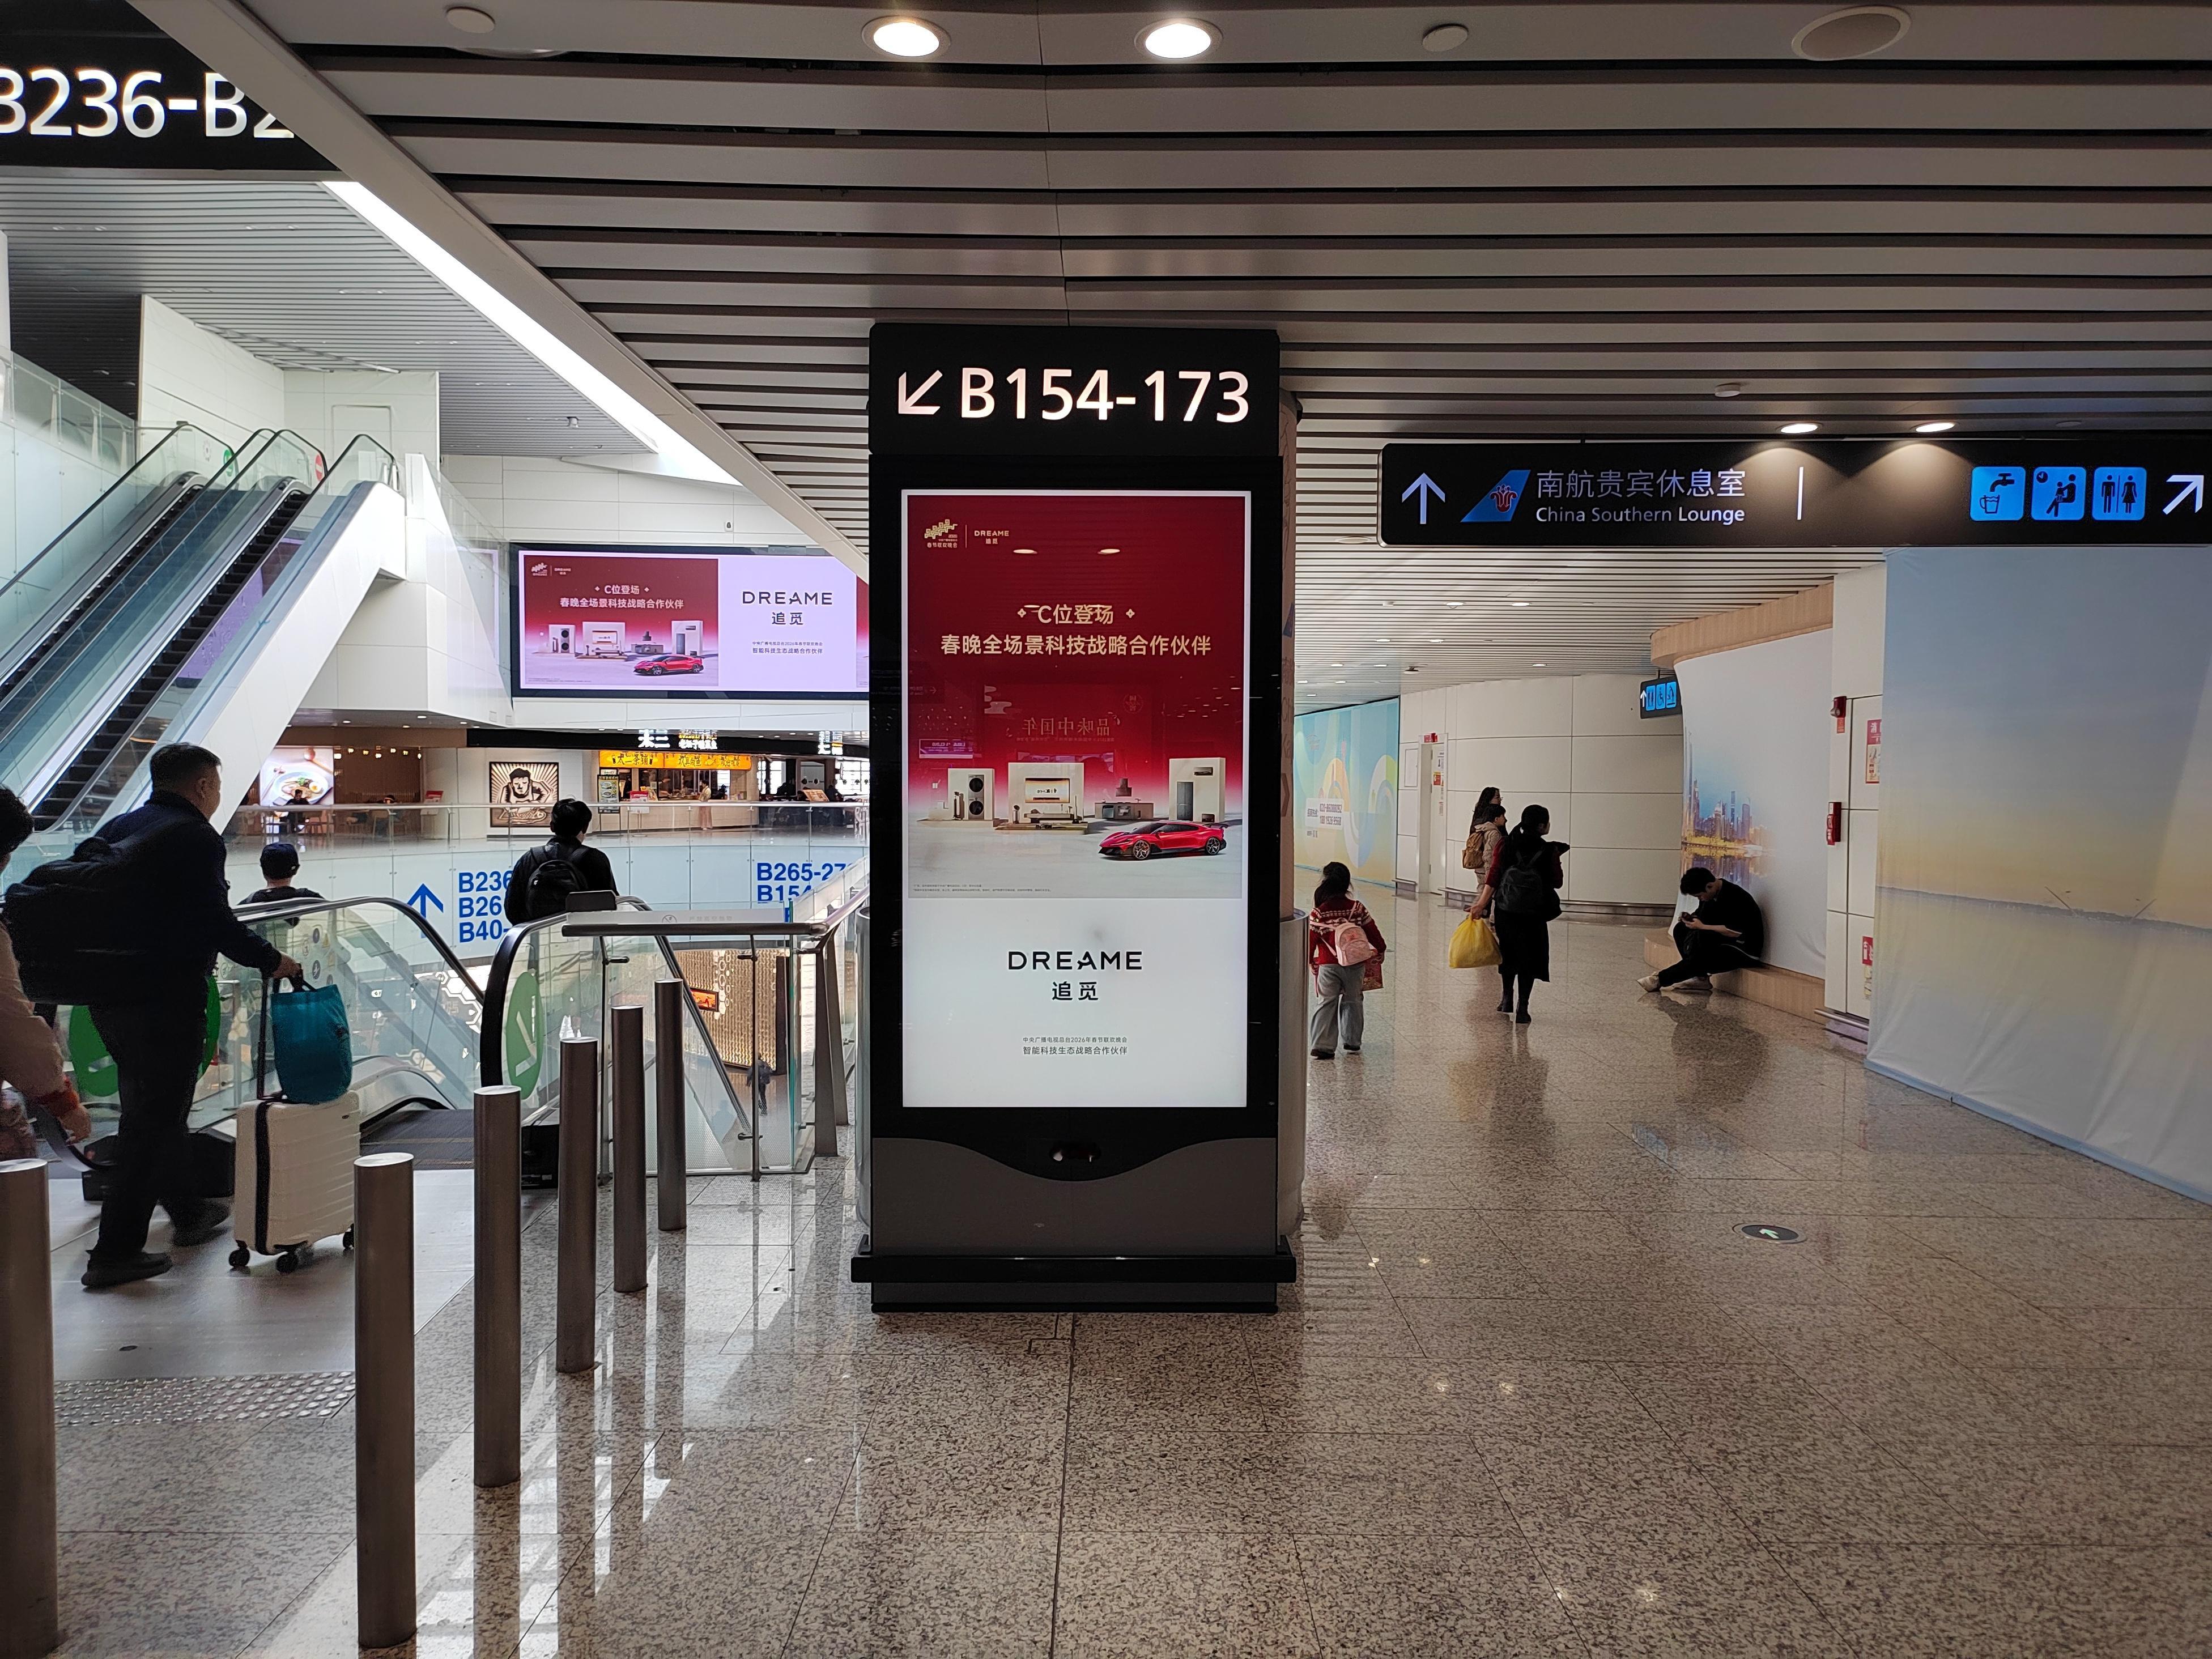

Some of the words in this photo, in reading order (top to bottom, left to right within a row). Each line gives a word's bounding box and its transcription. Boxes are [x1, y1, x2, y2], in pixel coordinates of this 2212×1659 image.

[961, 367, 1249, 423] B154-173
[1537, 469, 1745, 498] 南航贵宾休息室
[1536, 507, 1585, 522] China
[1592, 507, 1672, 522] Southern
[1679, 507, 1745, 526] Lounge
[604, 585, 640, 595] C位登场
[742, 591, 832, 605] DREAME
[560, 597, 684, 609] 春晚全场景科技战略合作伙伴
[772, 612, 803, 625] 追觅
[1037, 604, 1114, 624] C位登场
[941, 634, 1211, 656] 春晚全场景科技战略合作伙伴
[757, 862, 852, 882] B265-27
[1009, 951, 1142, 970] DREAME
[1052, 981, 1099, 1001] 追觅
[1023, 1046, 1128, 1055] 智能科技生态战略合作伙伴
